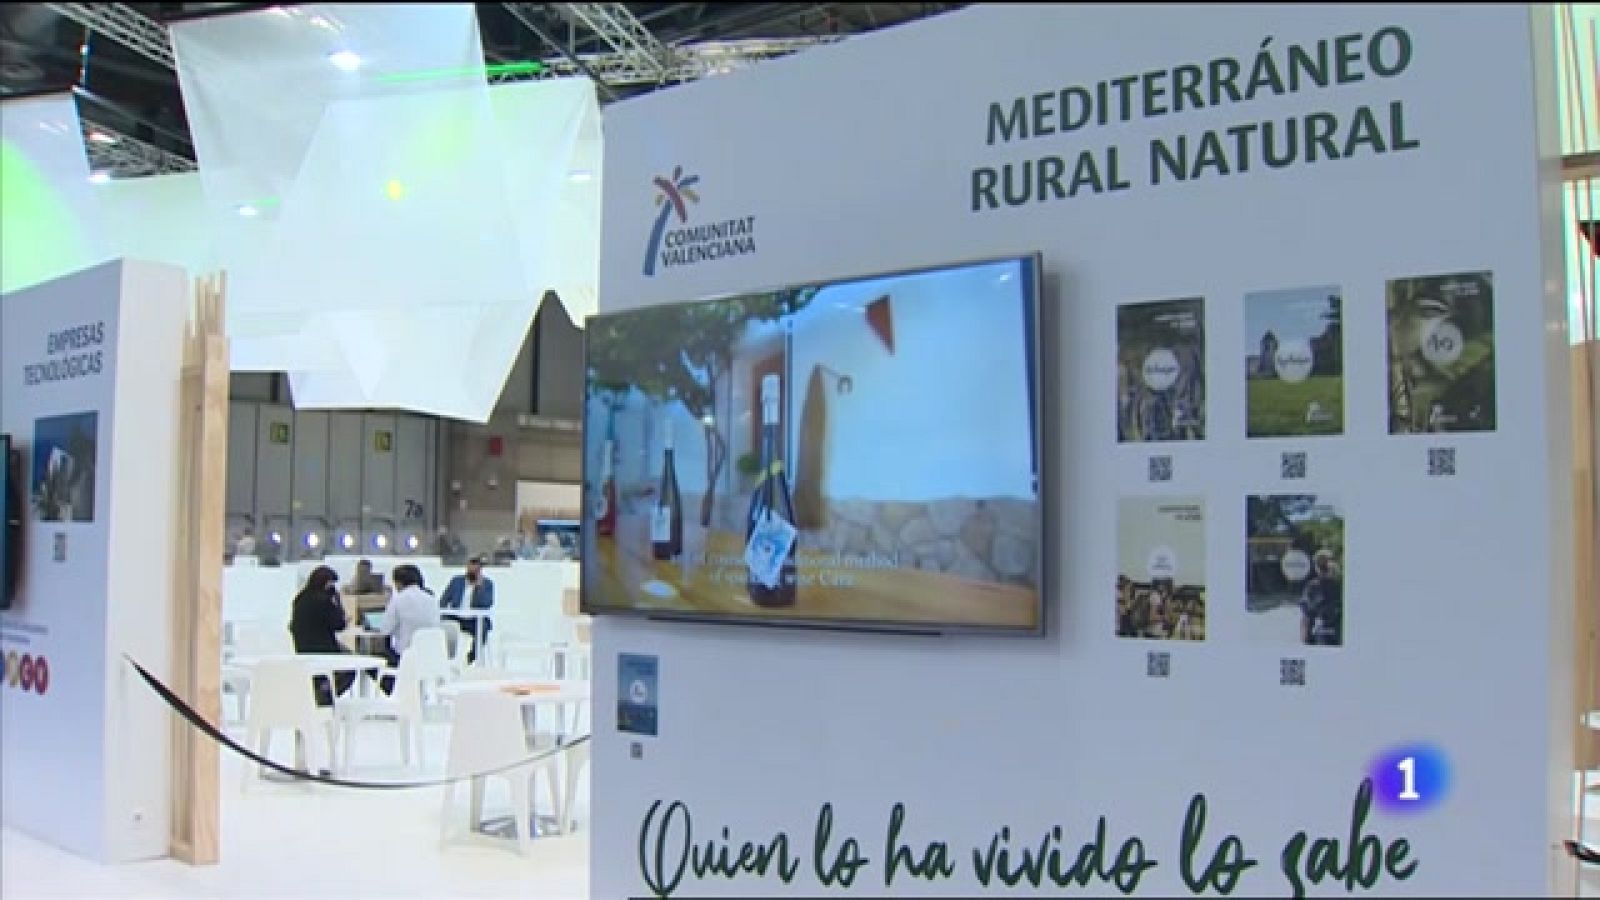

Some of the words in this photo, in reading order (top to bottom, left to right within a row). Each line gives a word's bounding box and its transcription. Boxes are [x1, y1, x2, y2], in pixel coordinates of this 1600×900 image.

[985, 24, 1414, 146] MEDITERRÁNEO
[970, 146, 1131, 212] RURAL
[1149, 100, 1421, 185] NATURAL
[661, 236, 756, 267] VALENCIANA
[665, 215, 756, 248] COMUNITAT
[47, 320, 104, 355] EMPRESAS
[639, 799, 801, 899] Quien
[814, 801, 871, 888] lo
[884, 801, 955, 888] ha
[973, 815, 1158, 896] vivido
[1179, 792, 1259, 896] lo
[1281, 776, 1419, 899] sabe
